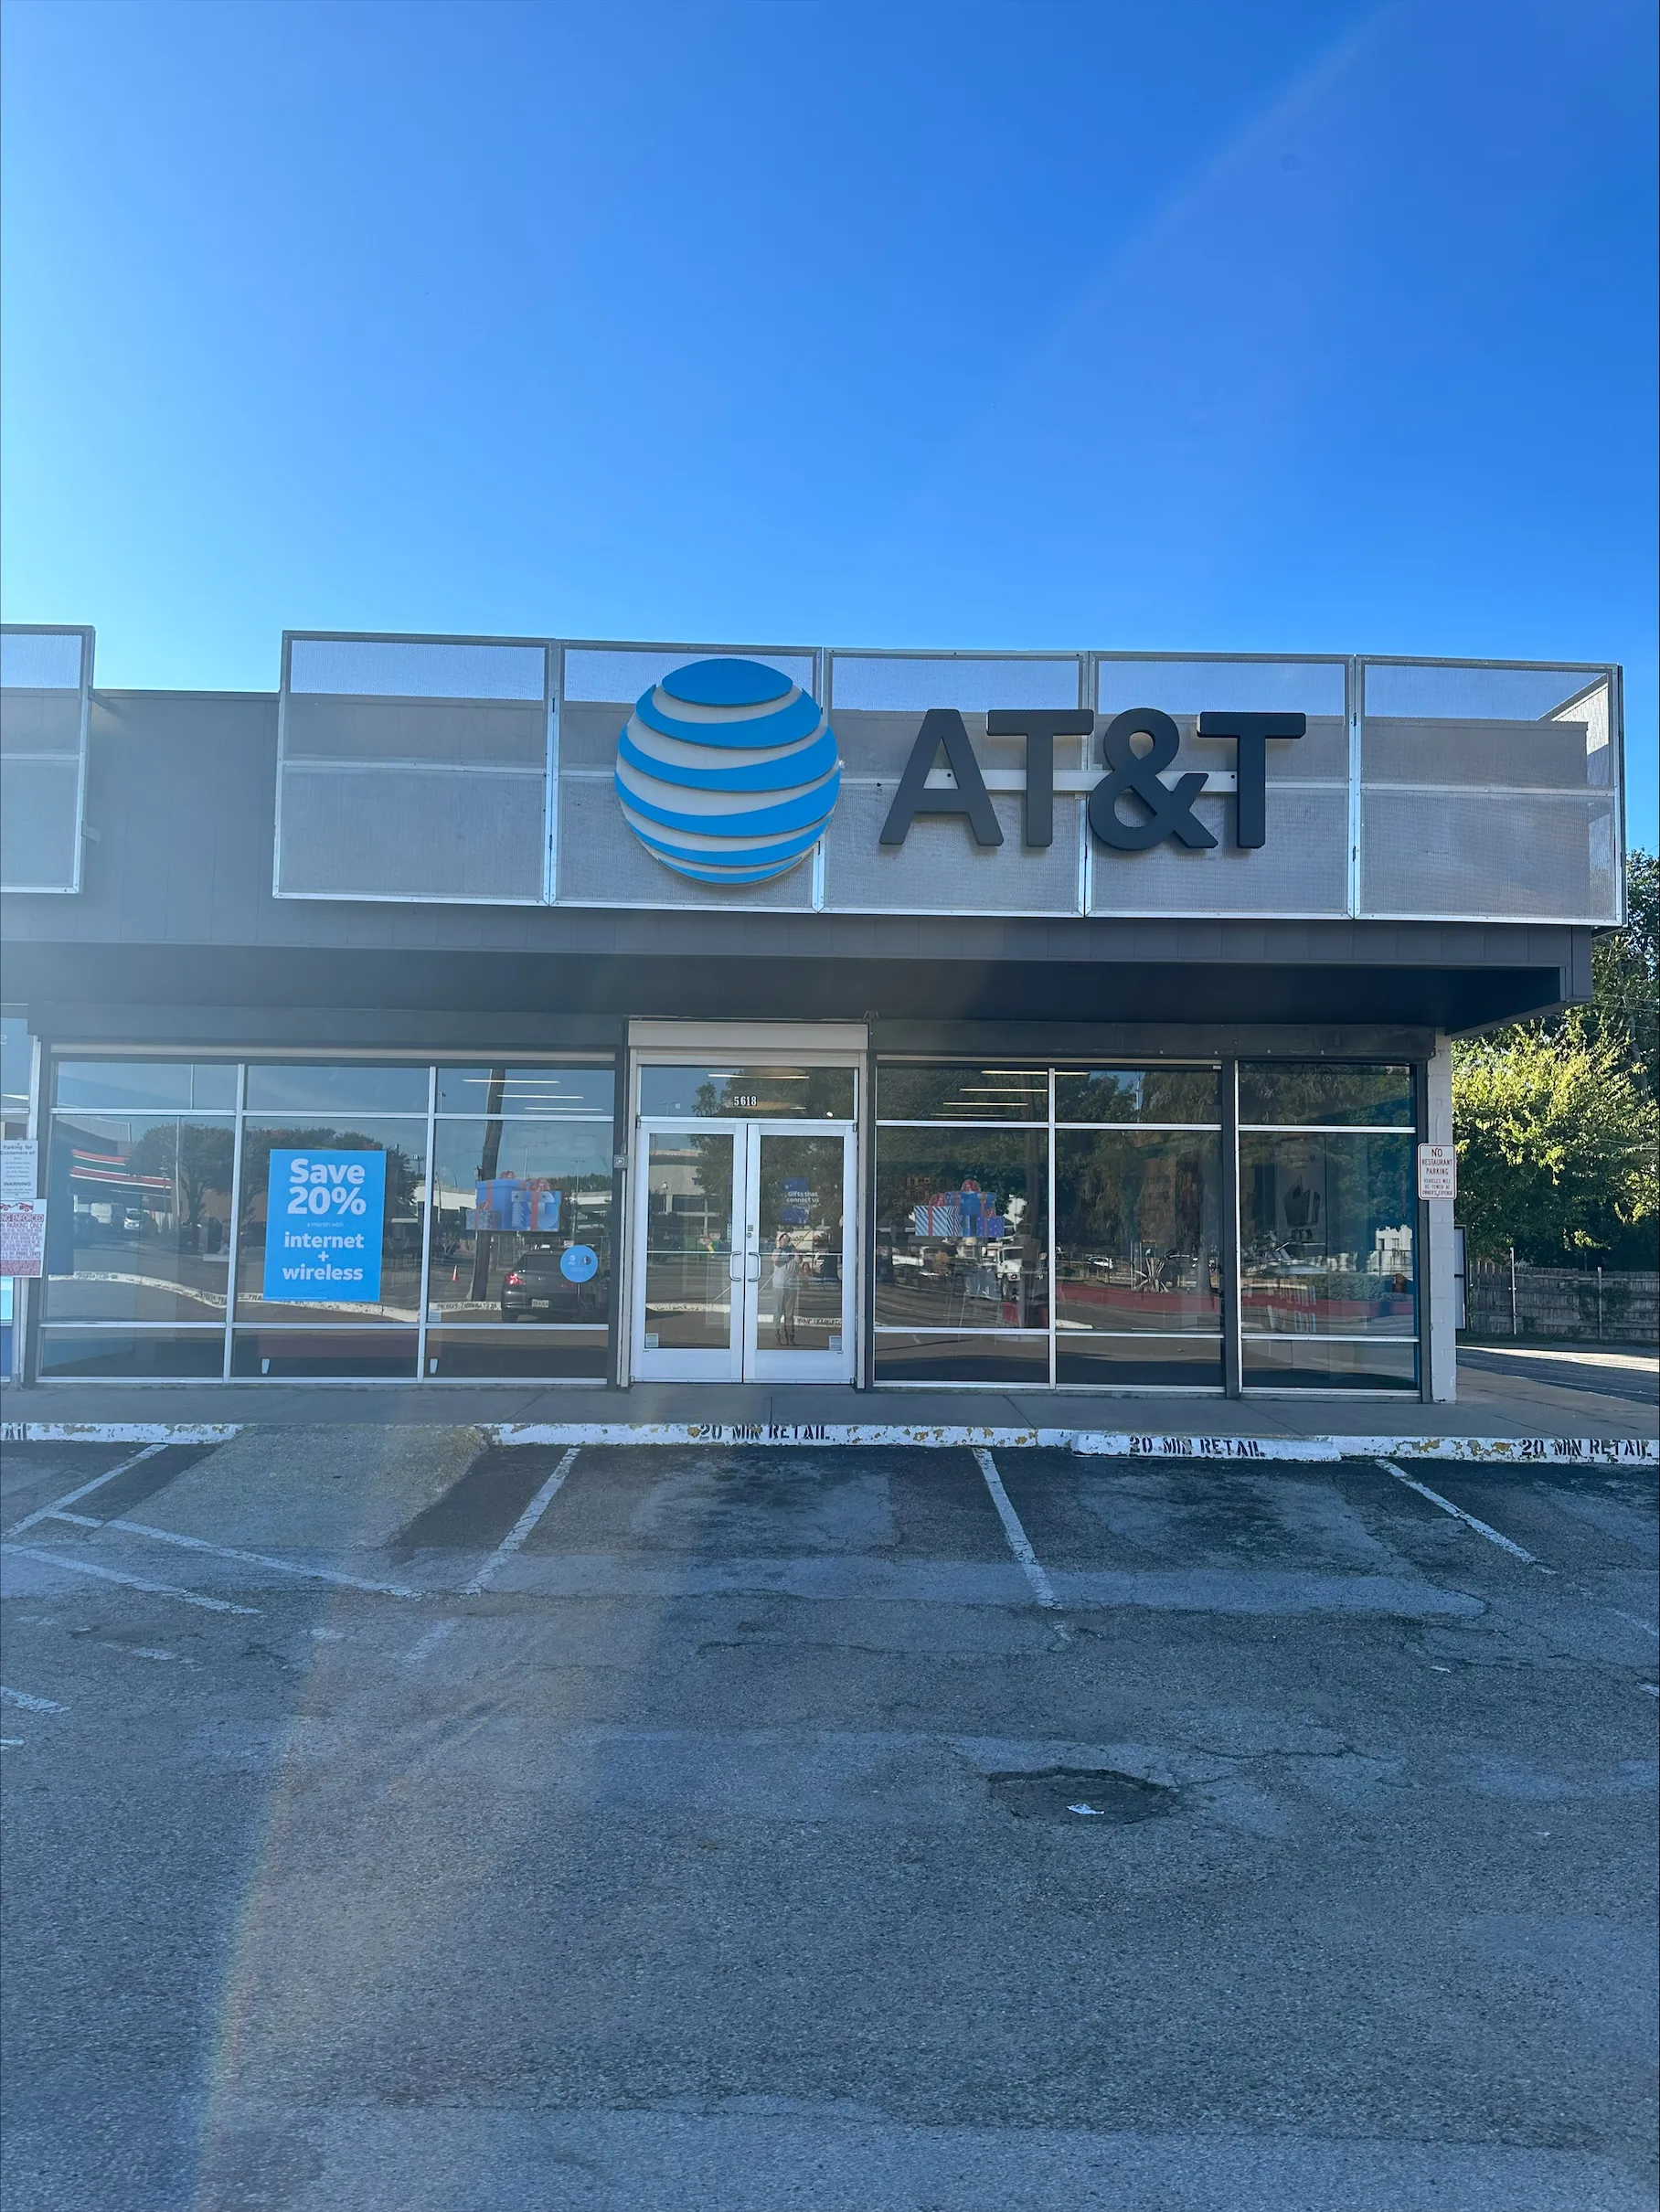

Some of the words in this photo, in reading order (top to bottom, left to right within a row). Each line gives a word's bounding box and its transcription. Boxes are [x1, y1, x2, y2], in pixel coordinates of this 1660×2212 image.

[878, 707, 1306, 851] AT&T
[733, 1095, 757, 1107] 5618
[1431, 1148, 1443, 1157] NO
[290, 1158, 365, 1185] Save
[287, 1186, 367, 1216] 20%
[12, 1214, 44, 1222] ENFORCED
[283, 1231, 364, 1249] internet
[318, 1251, 329, 1261] +
[282, 1263, 364, 1281] wireless
[699, 1423, 722, 1441] 20
[732, 1423, 763, 1440] MIN
[769, 1423, 830, 1440] RETAIL
[1129, 1436, 1153, 1453] 20
[1163, 1437, 1192, 1455] MIN
[1200, 1438, 1266, 1458] RETAIL
[1520, 1439, 1545, 1458] 20
[1554, 1438, 1582, 1457] MIN
[1590, 1439, 1653, 1458] RETAIL
